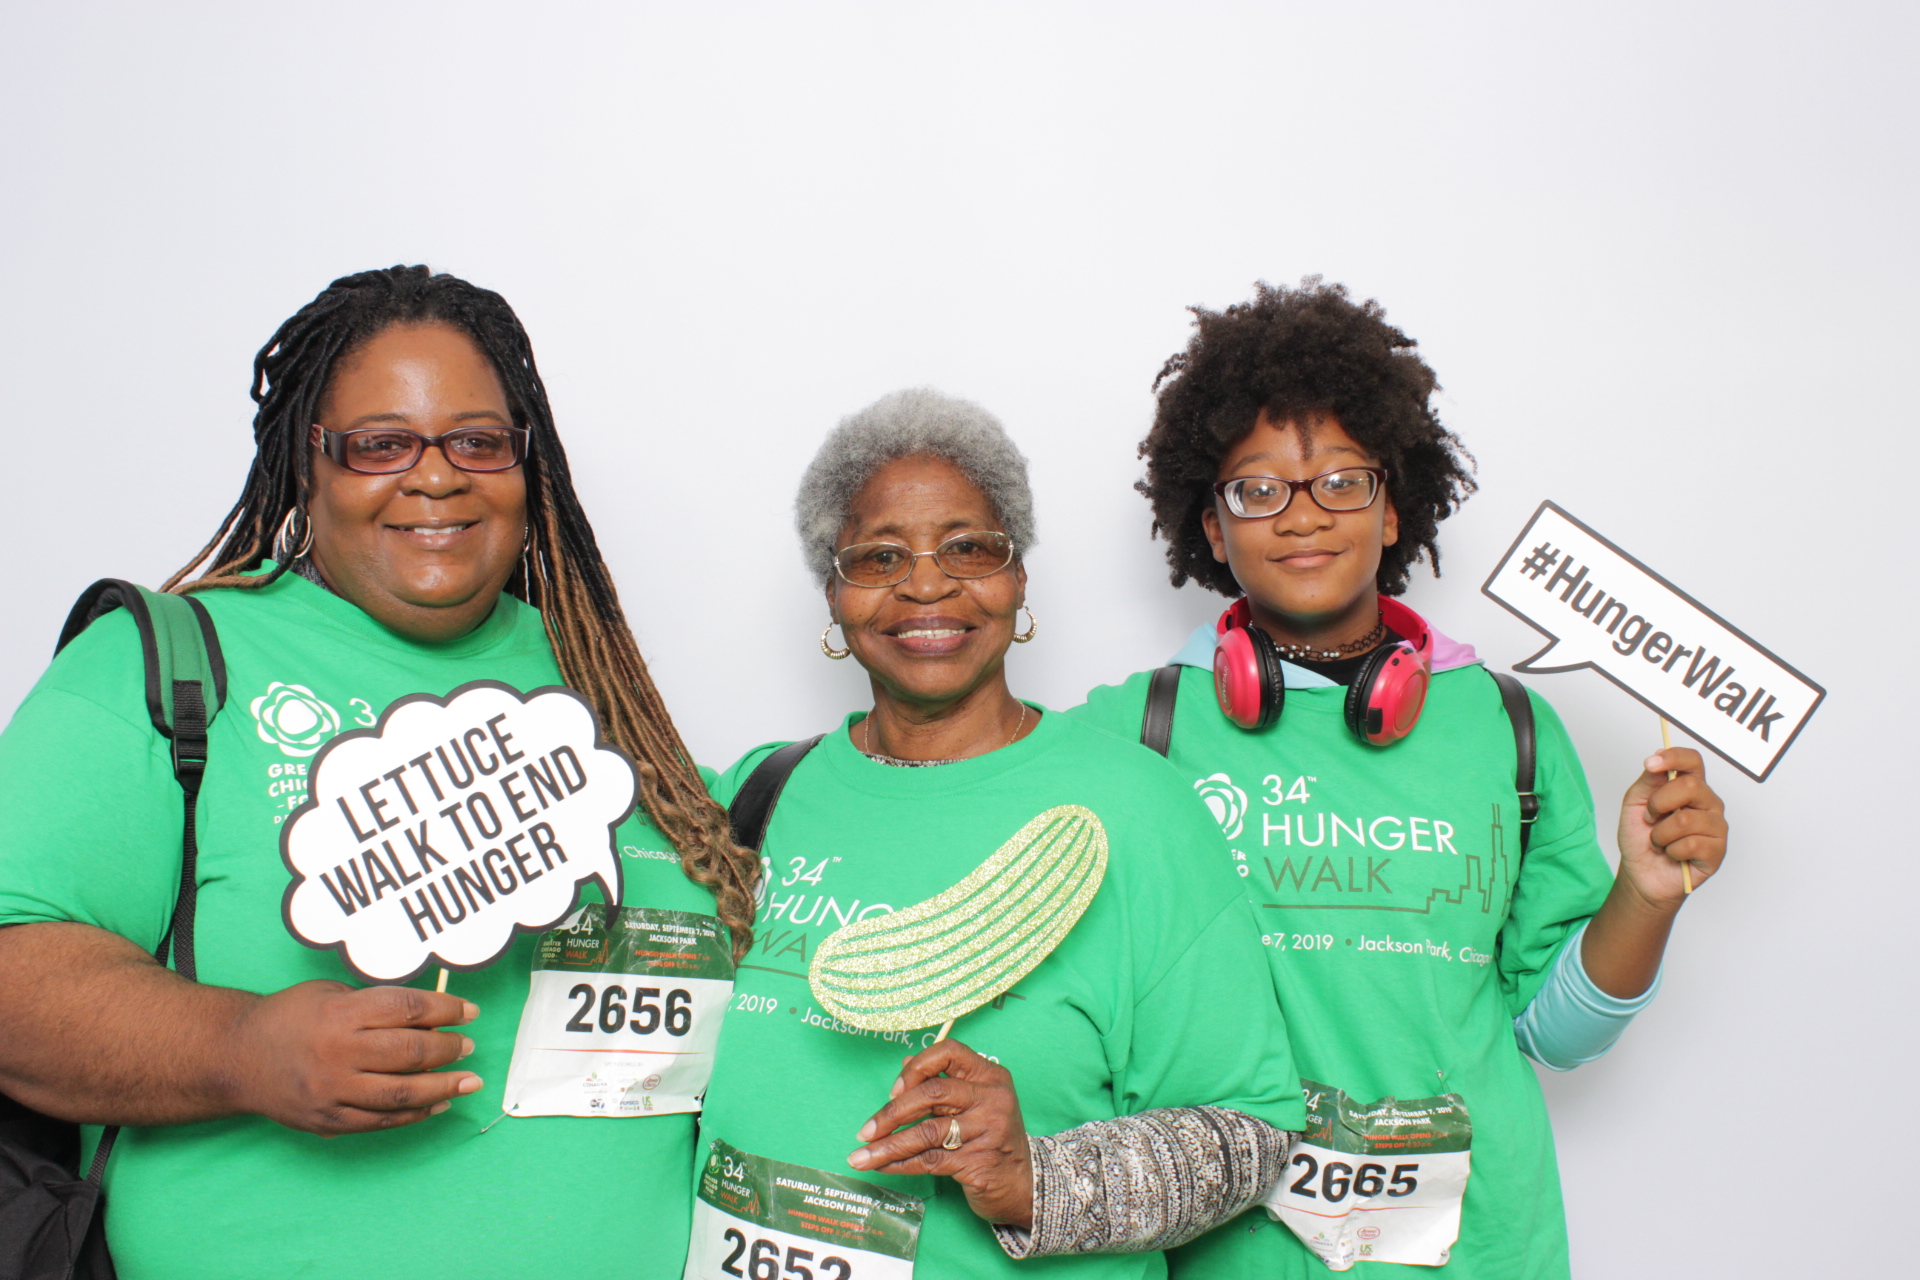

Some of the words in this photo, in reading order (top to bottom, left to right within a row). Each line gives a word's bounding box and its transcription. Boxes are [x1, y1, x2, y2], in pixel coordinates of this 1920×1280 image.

[1519, 541, 1785, 743] #HungerWalk
[336, 712, 525, 843] LETTUCE
[319, 819, 449, 917] WALK
[439, 791, 502, 851] TO
[499, 745, 587, 823] END
[1262, 812, 1458, 855] HUNGER
[623, 845, 682, 864] Chicago
[399, 821, 568, 942] HUNGER
[1263, 855, 1392, 893] WALK
[624, 921, 660, 932] SATURDAY,
[662, 924, 695, 935] SEPTEMBER
[566, 938, 600, 948] HUNGER
[649, 934, 680, 944] JACKSON
[680, 937, 697, 945] PARK
[1291, 934, 1334, 950] 2019
[1357, 935, 1423, 953] Jackson
[1425, 939, 1453, 961] Park,
[566, 950, 588, 959] WALK
[565, 983, 692, 1037] 2656
[736, 993, 778, 1015] 2019
[1349, 1108, 1388, 1119] SATUDAY,
[1374, 1118, 1412, 1126] JACKSON
[1413, 1117, 1431, 1125] PARK
[721, 1179, 750, 1198] HUNGER
[1290, 1153, 1419, 1203] 2665
[721, 1190, 738, 1204] WALK
[775, 1177, 822, 1195] SATURDAY,
[824, 1188, 873, 1206] SEPTEMBER
[884, 1203, 906, 1214] 2019
[803, 1195, 844, 1211] JACKSON
[845, 1204, 870, 1217] PARK
[787, 1208, 817, 1221] HUNGER
[818, 1215, 839, 1226] WALK
[840, 1221, 865, 1232] OPENS
[800, 1221, 819, 1232] STEPS
[820, 1226, 834, 1234] OFF
